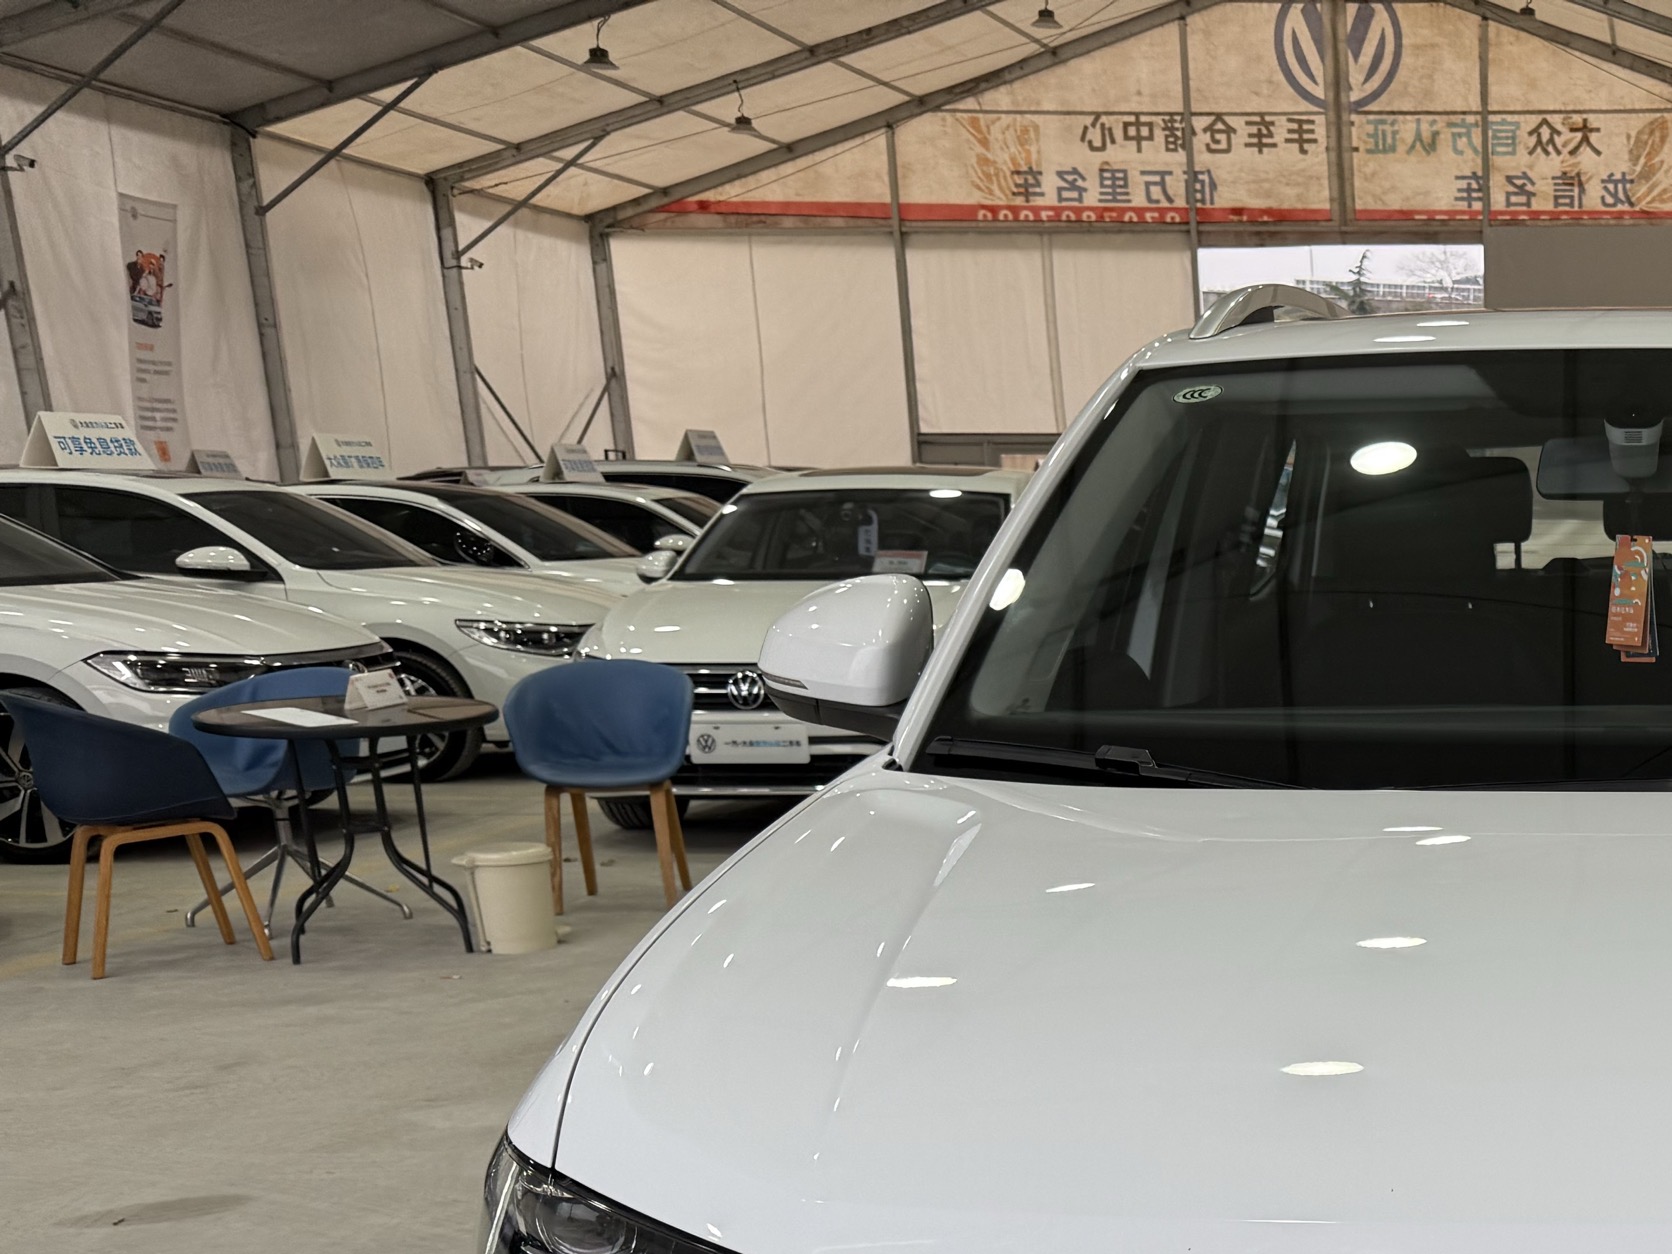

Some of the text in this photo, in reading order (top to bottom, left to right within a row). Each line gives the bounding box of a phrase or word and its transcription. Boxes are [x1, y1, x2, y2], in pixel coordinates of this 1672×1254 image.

[53, 435, 142, 457] 可享免息贷款
